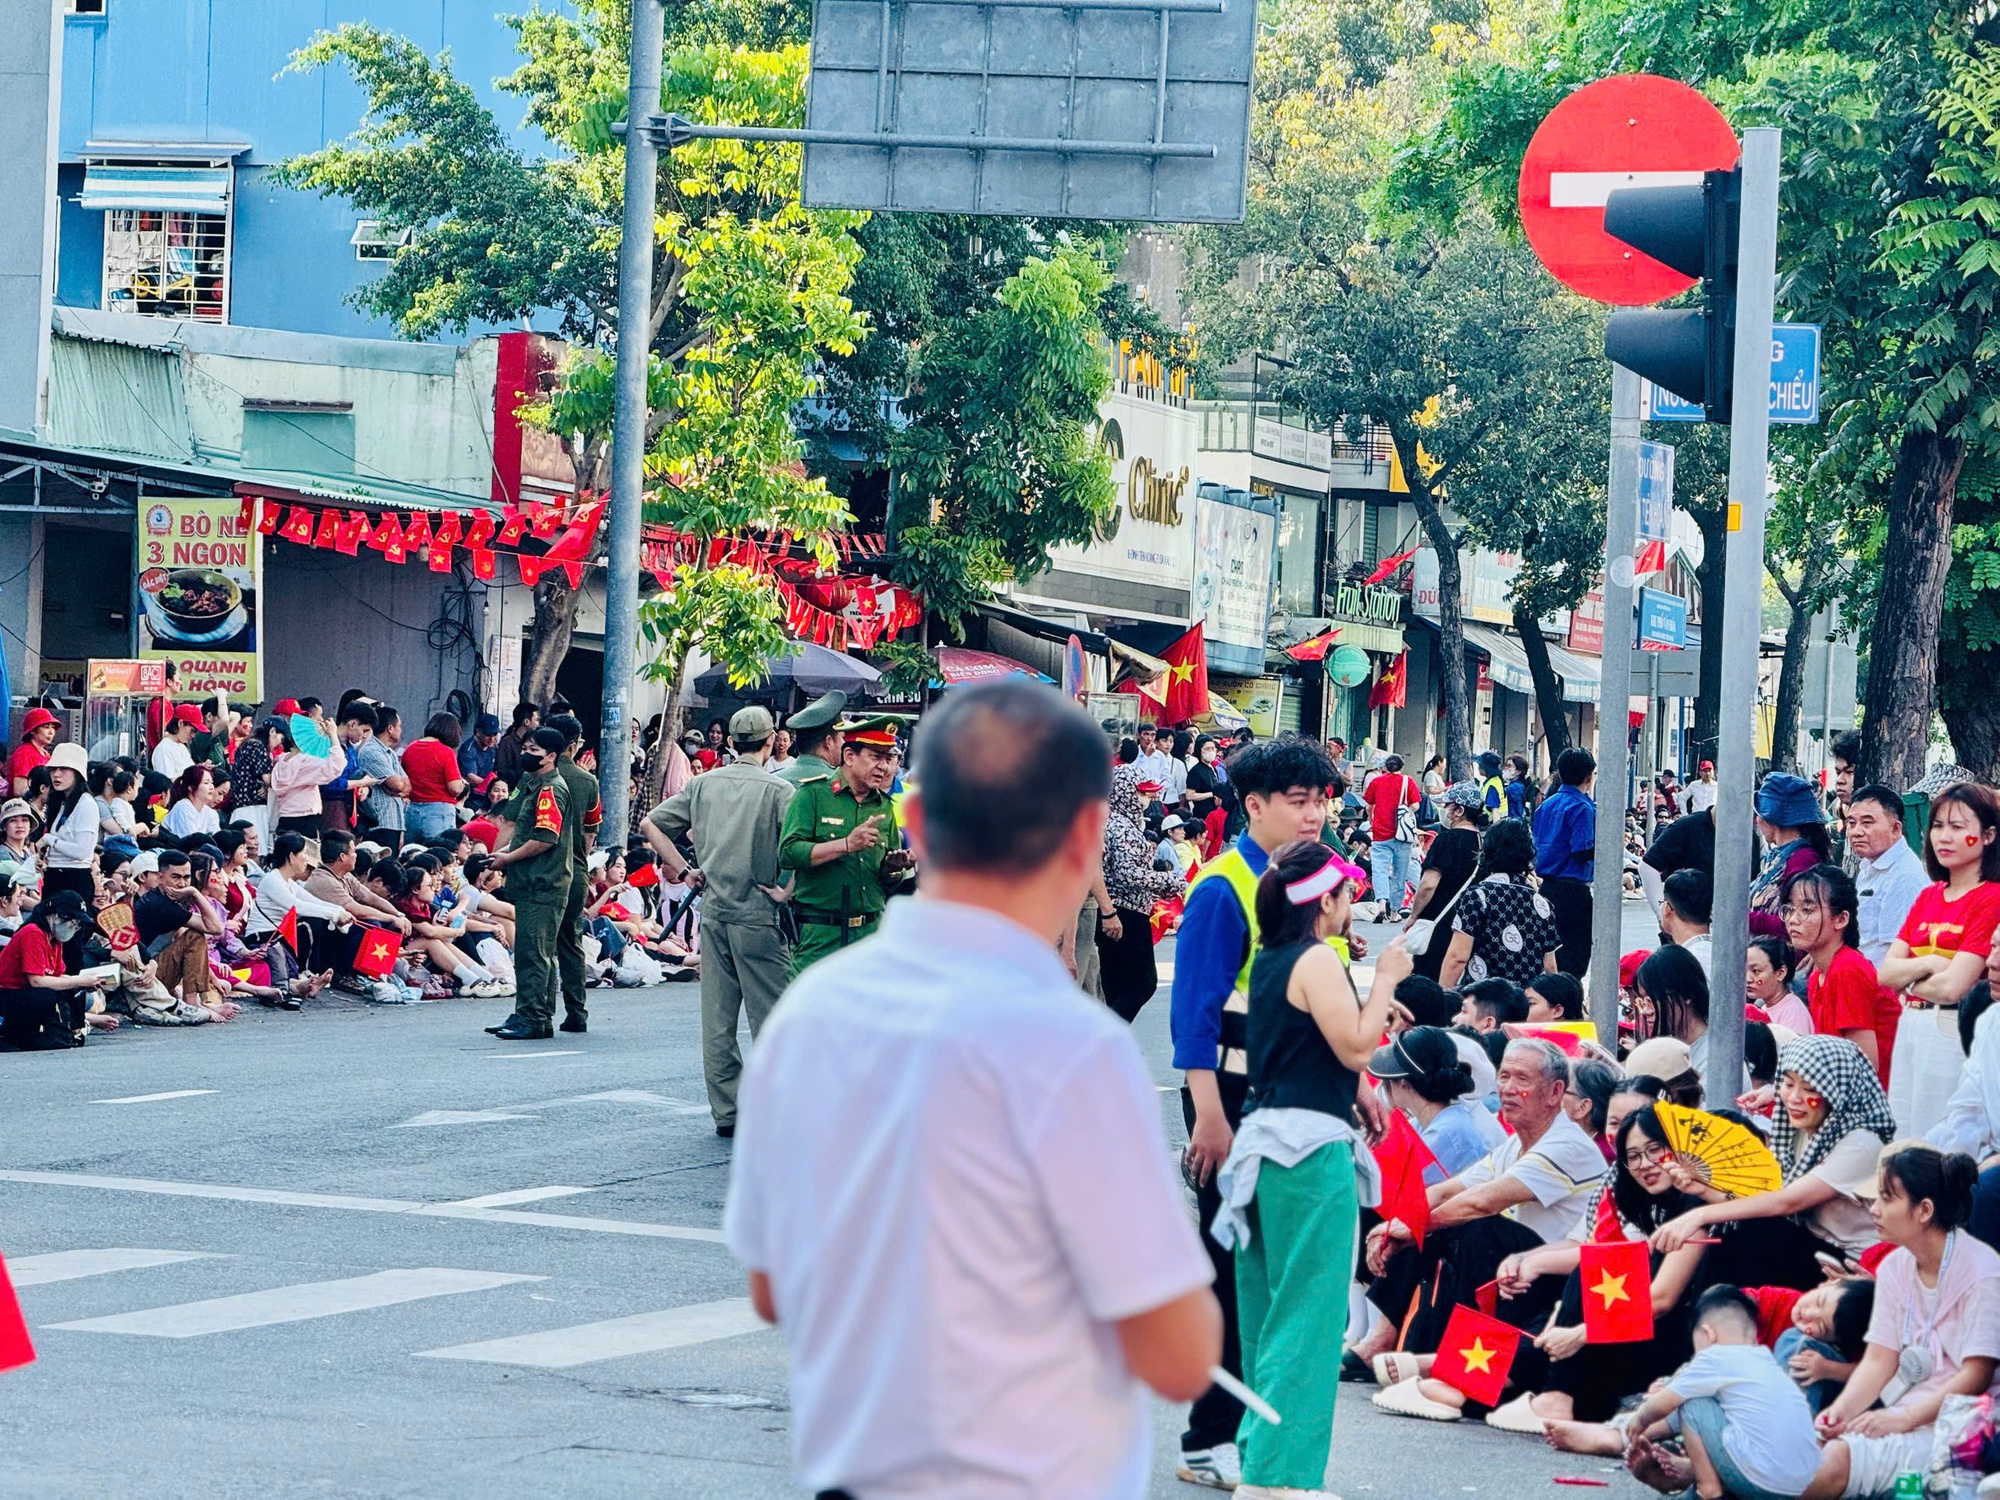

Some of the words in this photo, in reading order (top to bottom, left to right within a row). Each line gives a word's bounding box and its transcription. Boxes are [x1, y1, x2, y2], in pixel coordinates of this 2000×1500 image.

[1768, 369, 1812, 410] CHIỂU
[1129, 455, 1184, 527] Clinic
[180, 509, 211, 537] BÒ
[146, 541, 164, 564] 3
[173, 542, 247, 566] NGON
[1361, 583, 1401, 622] Station
[179, 660, 247, 674] QUANH
